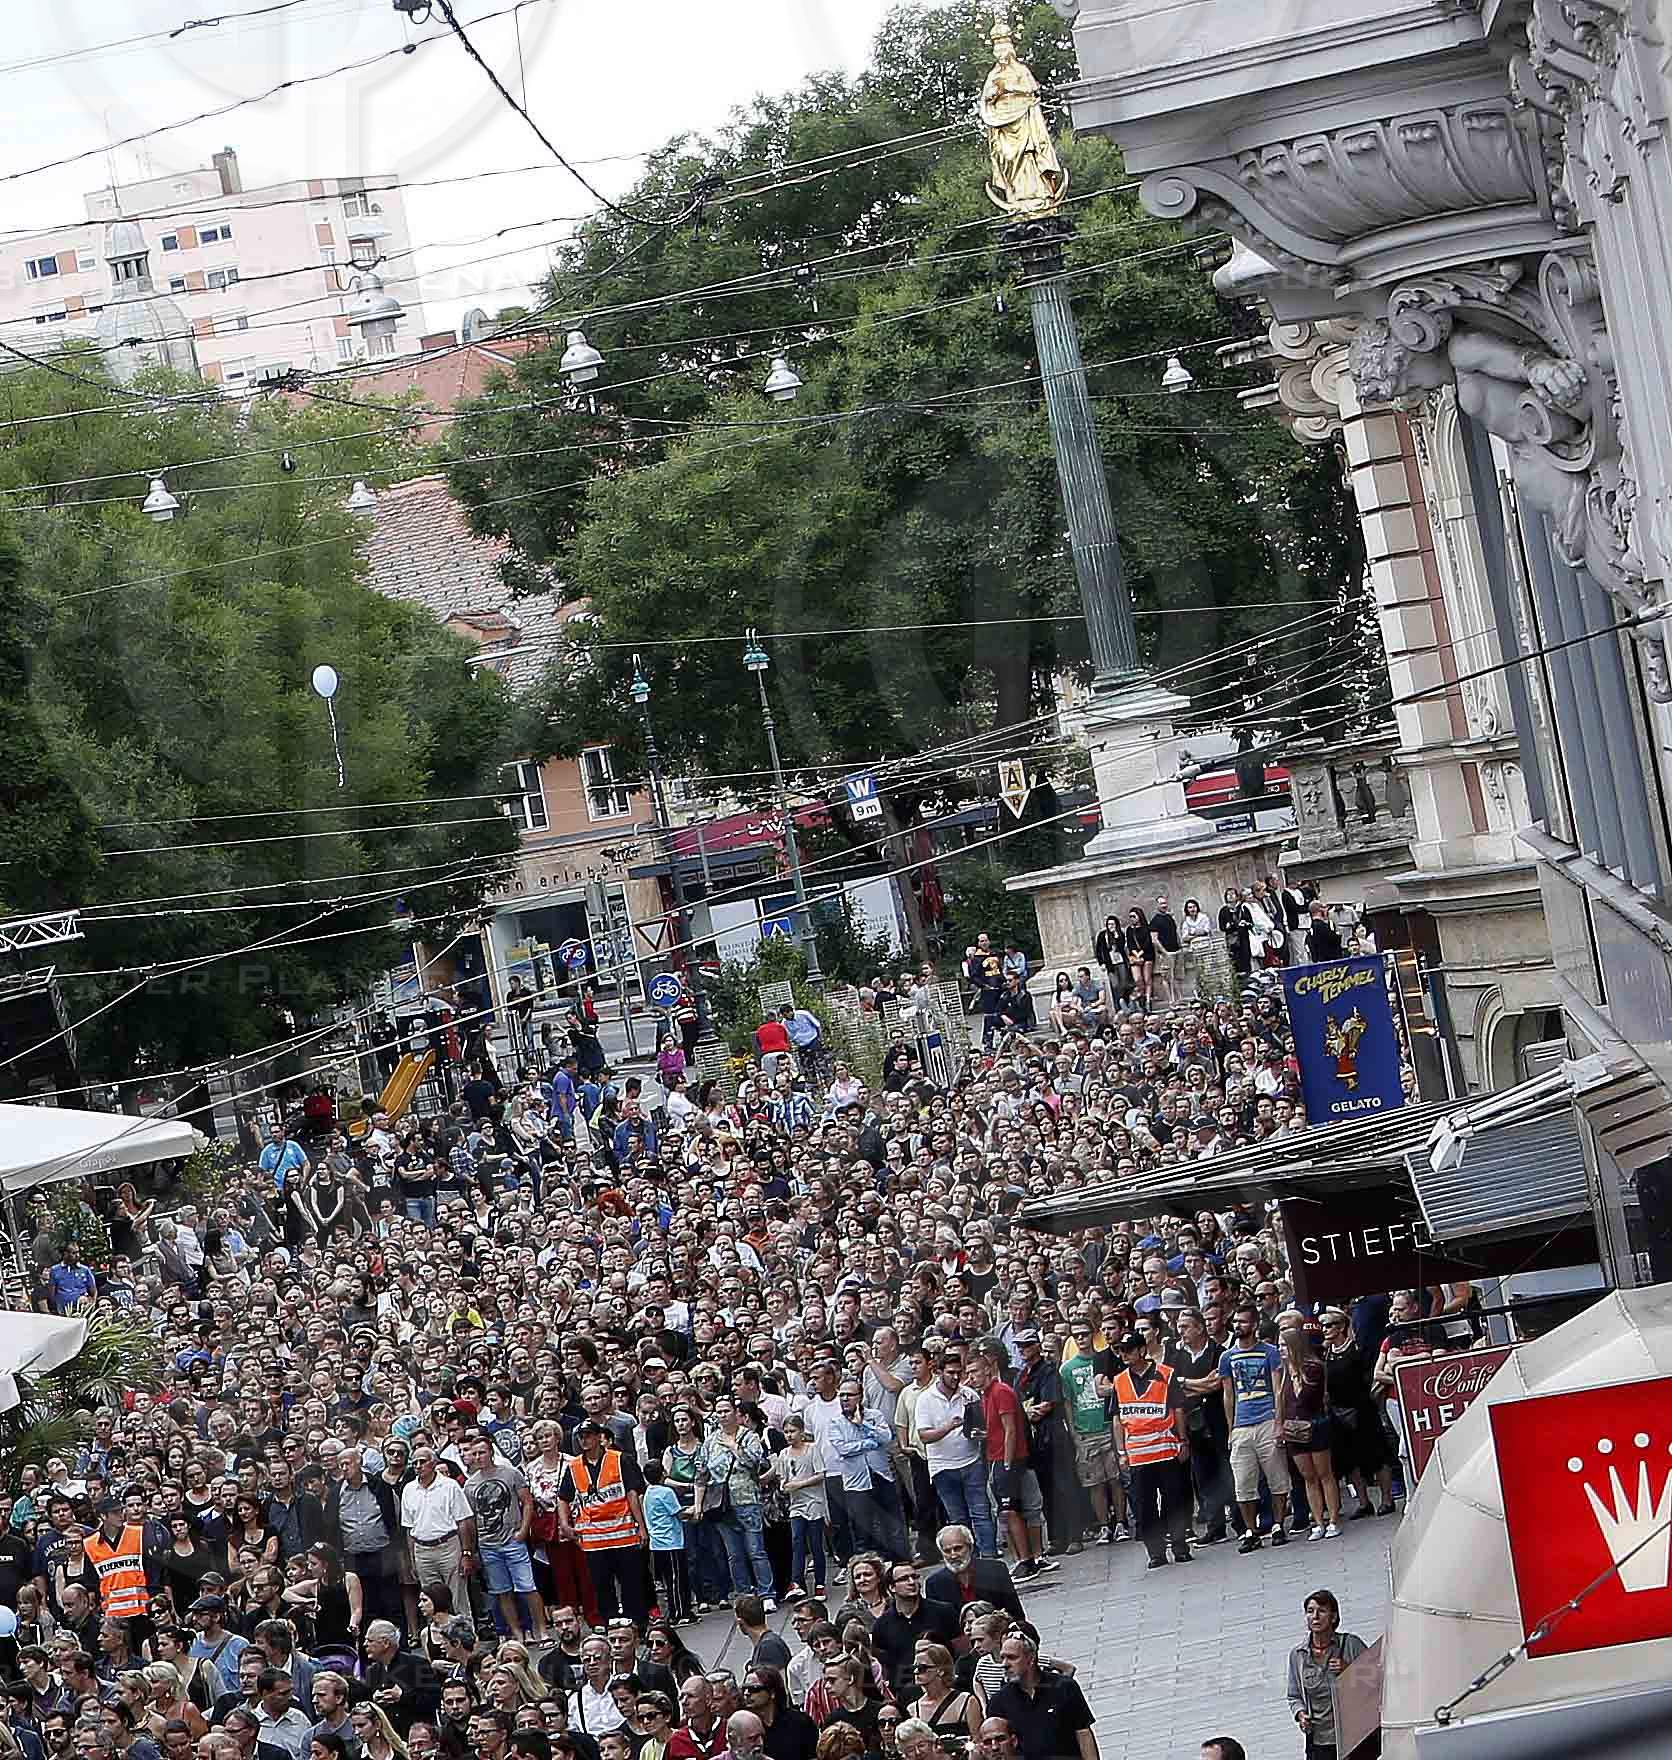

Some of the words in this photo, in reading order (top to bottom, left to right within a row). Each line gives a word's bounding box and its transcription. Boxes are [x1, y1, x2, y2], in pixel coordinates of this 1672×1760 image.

[847, 776, 870, 799] W
[1318, 969, 1376, 1004] TEMMEL
[1330, 1096, 1382, 1113] GELATO
